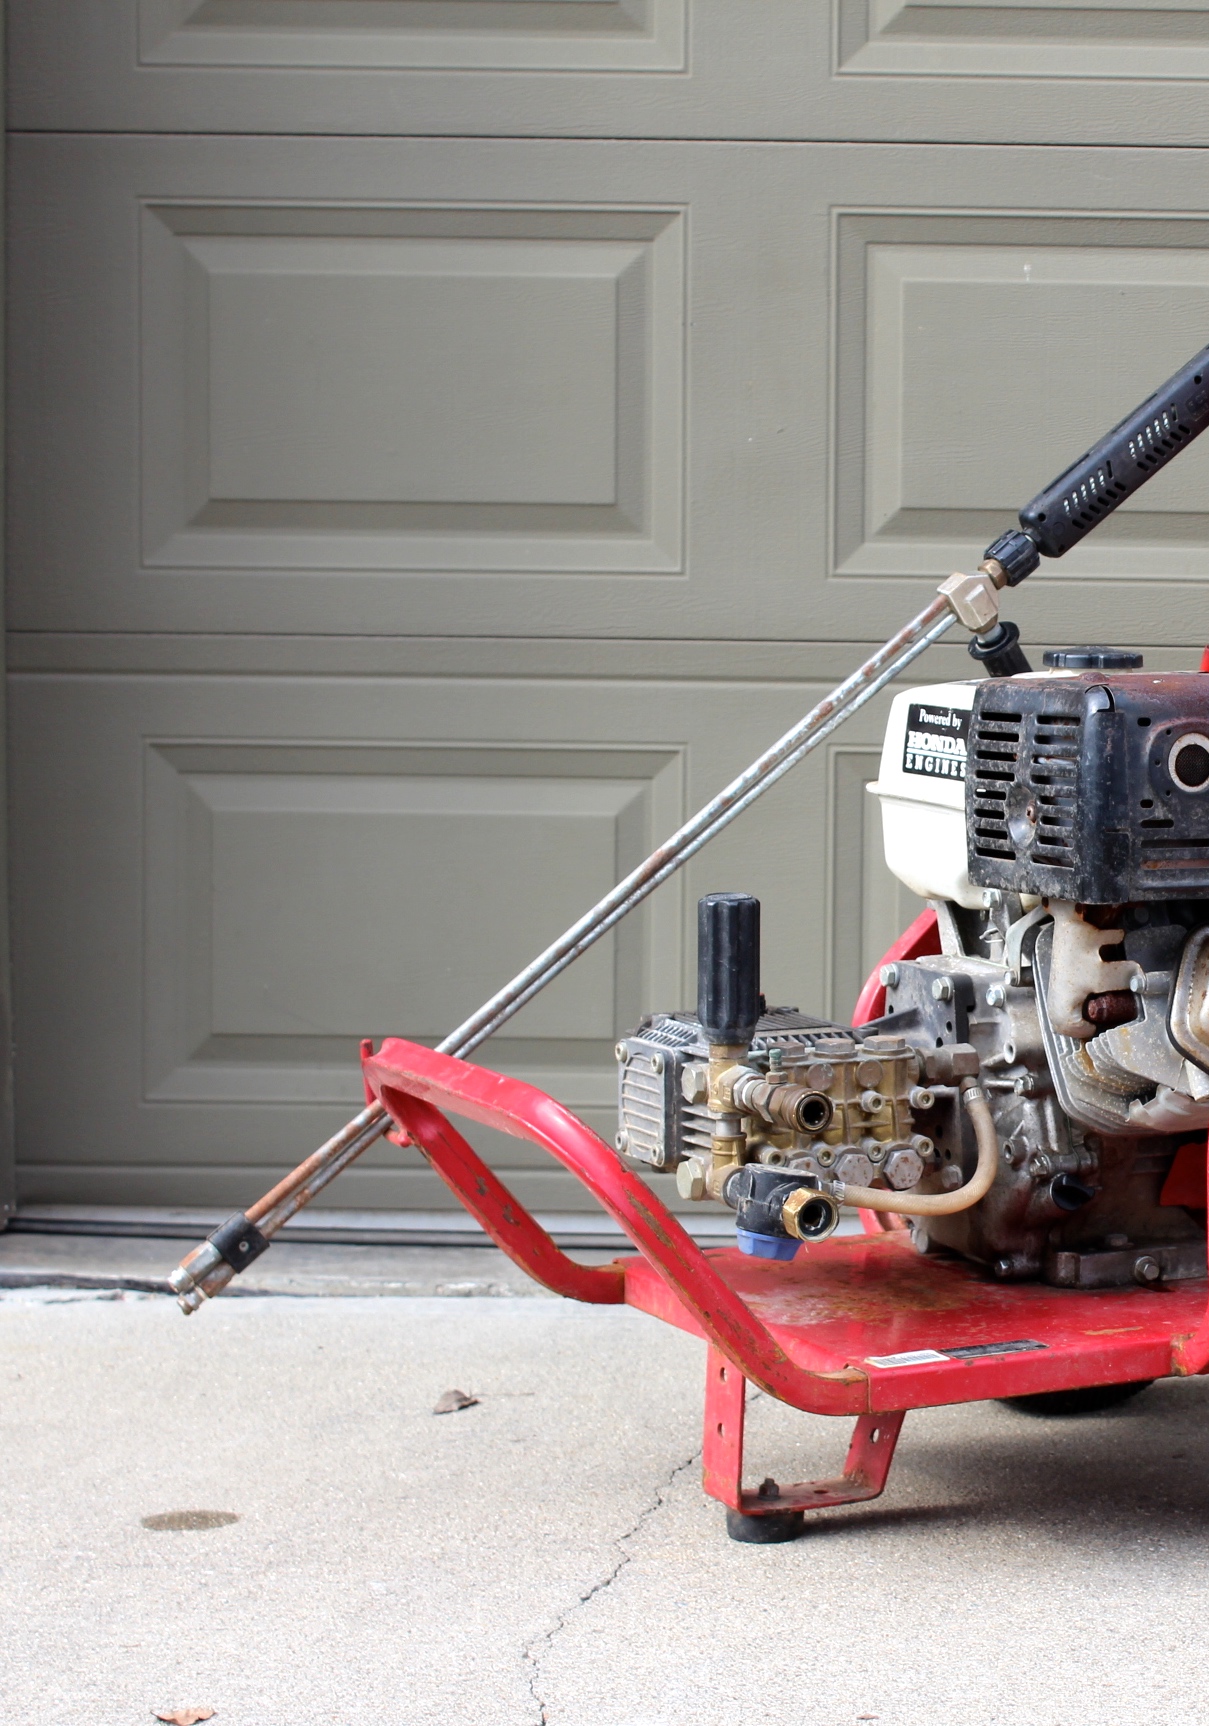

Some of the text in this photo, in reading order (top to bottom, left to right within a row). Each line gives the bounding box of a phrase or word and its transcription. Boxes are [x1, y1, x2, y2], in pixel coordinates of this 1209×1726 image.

[919, 708, 962, 730] Powered by
[907, 730, 967, 756] HONDA
[905, 753, 966, 777] ENGINES
